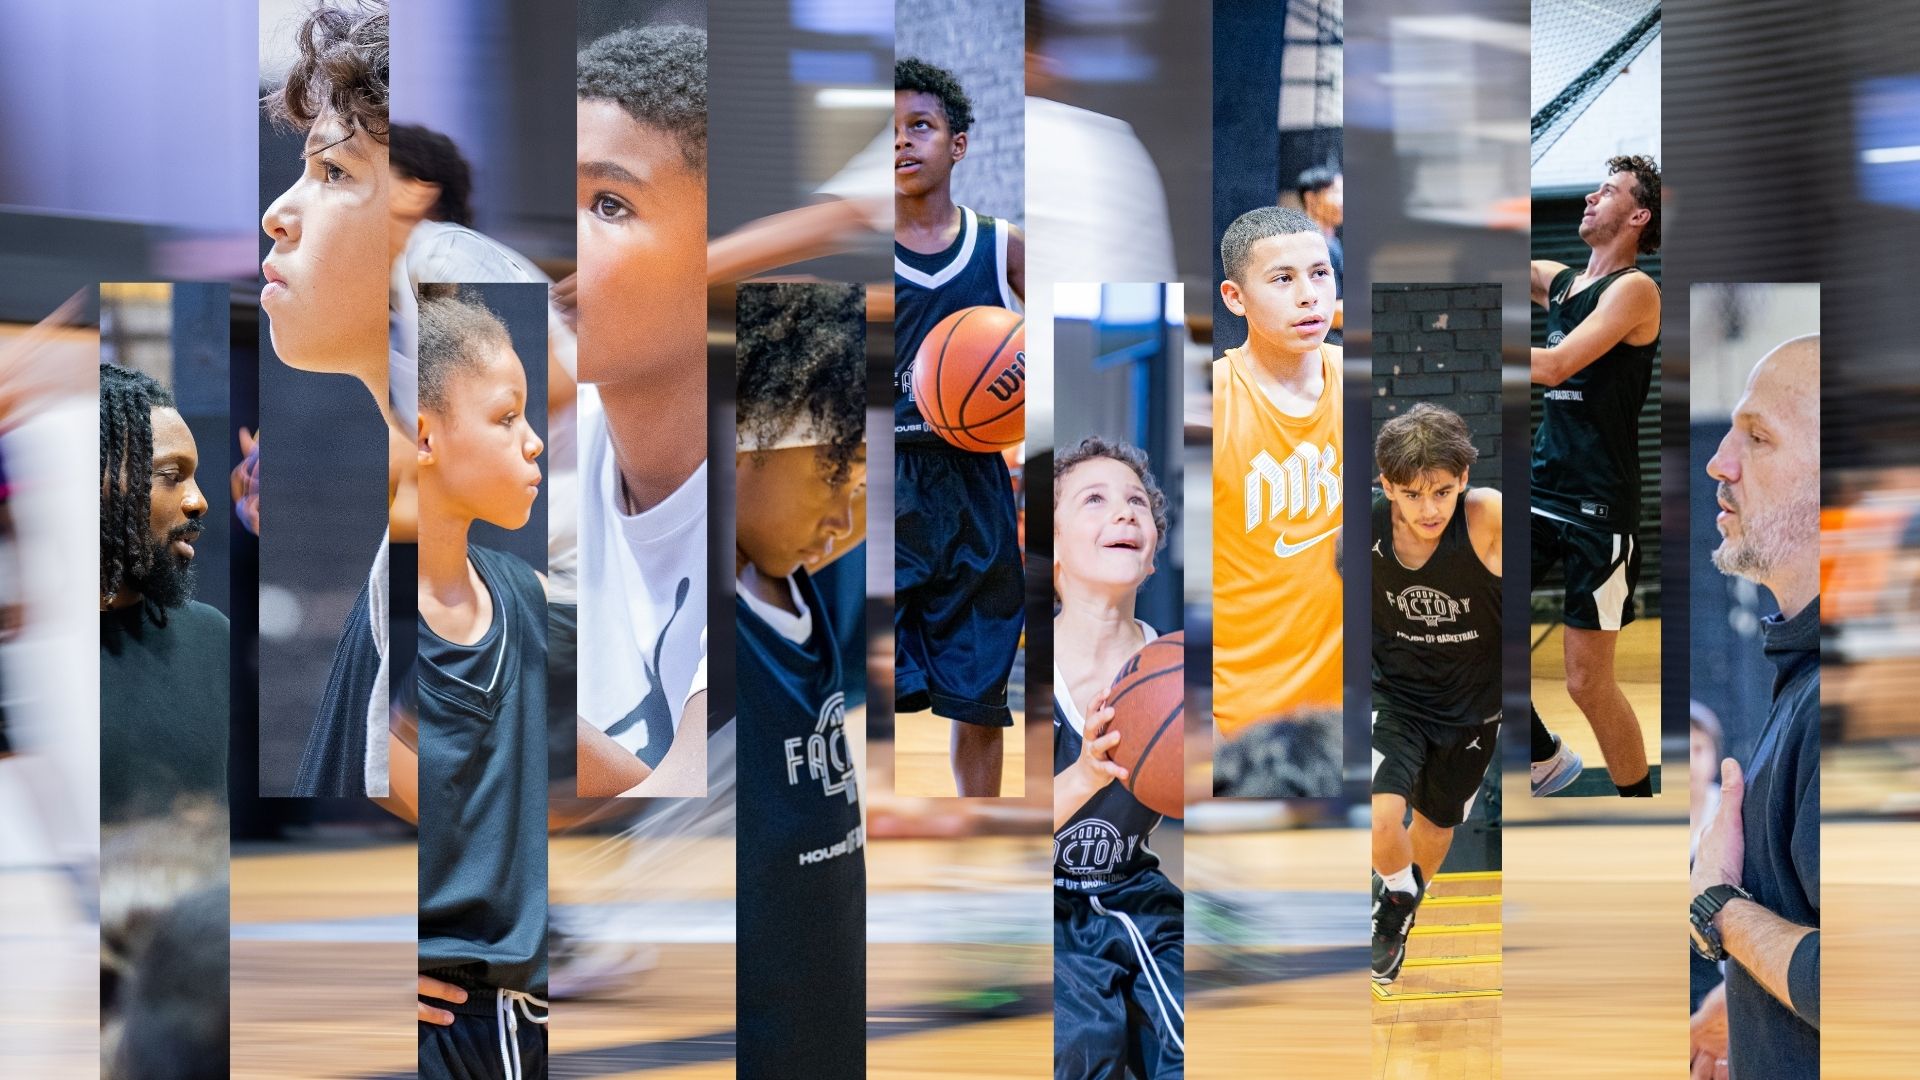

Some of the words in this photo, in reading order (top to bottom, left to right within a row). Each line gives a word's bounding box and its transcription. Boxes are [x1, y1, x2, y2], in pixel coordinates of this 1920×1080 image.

[895, 423, 922, 433] OUSE
[1244, 441, 1343, 534] NIK
[1385, 590, 1470, 616] FACTORY
[1425, 634, 1436, 643] OF
[1437, 630, 1479, 643] BASKETBALL
[1071, 826, 1107, 840] HOOPS
[799, 840, 847, 865] HOUSE
